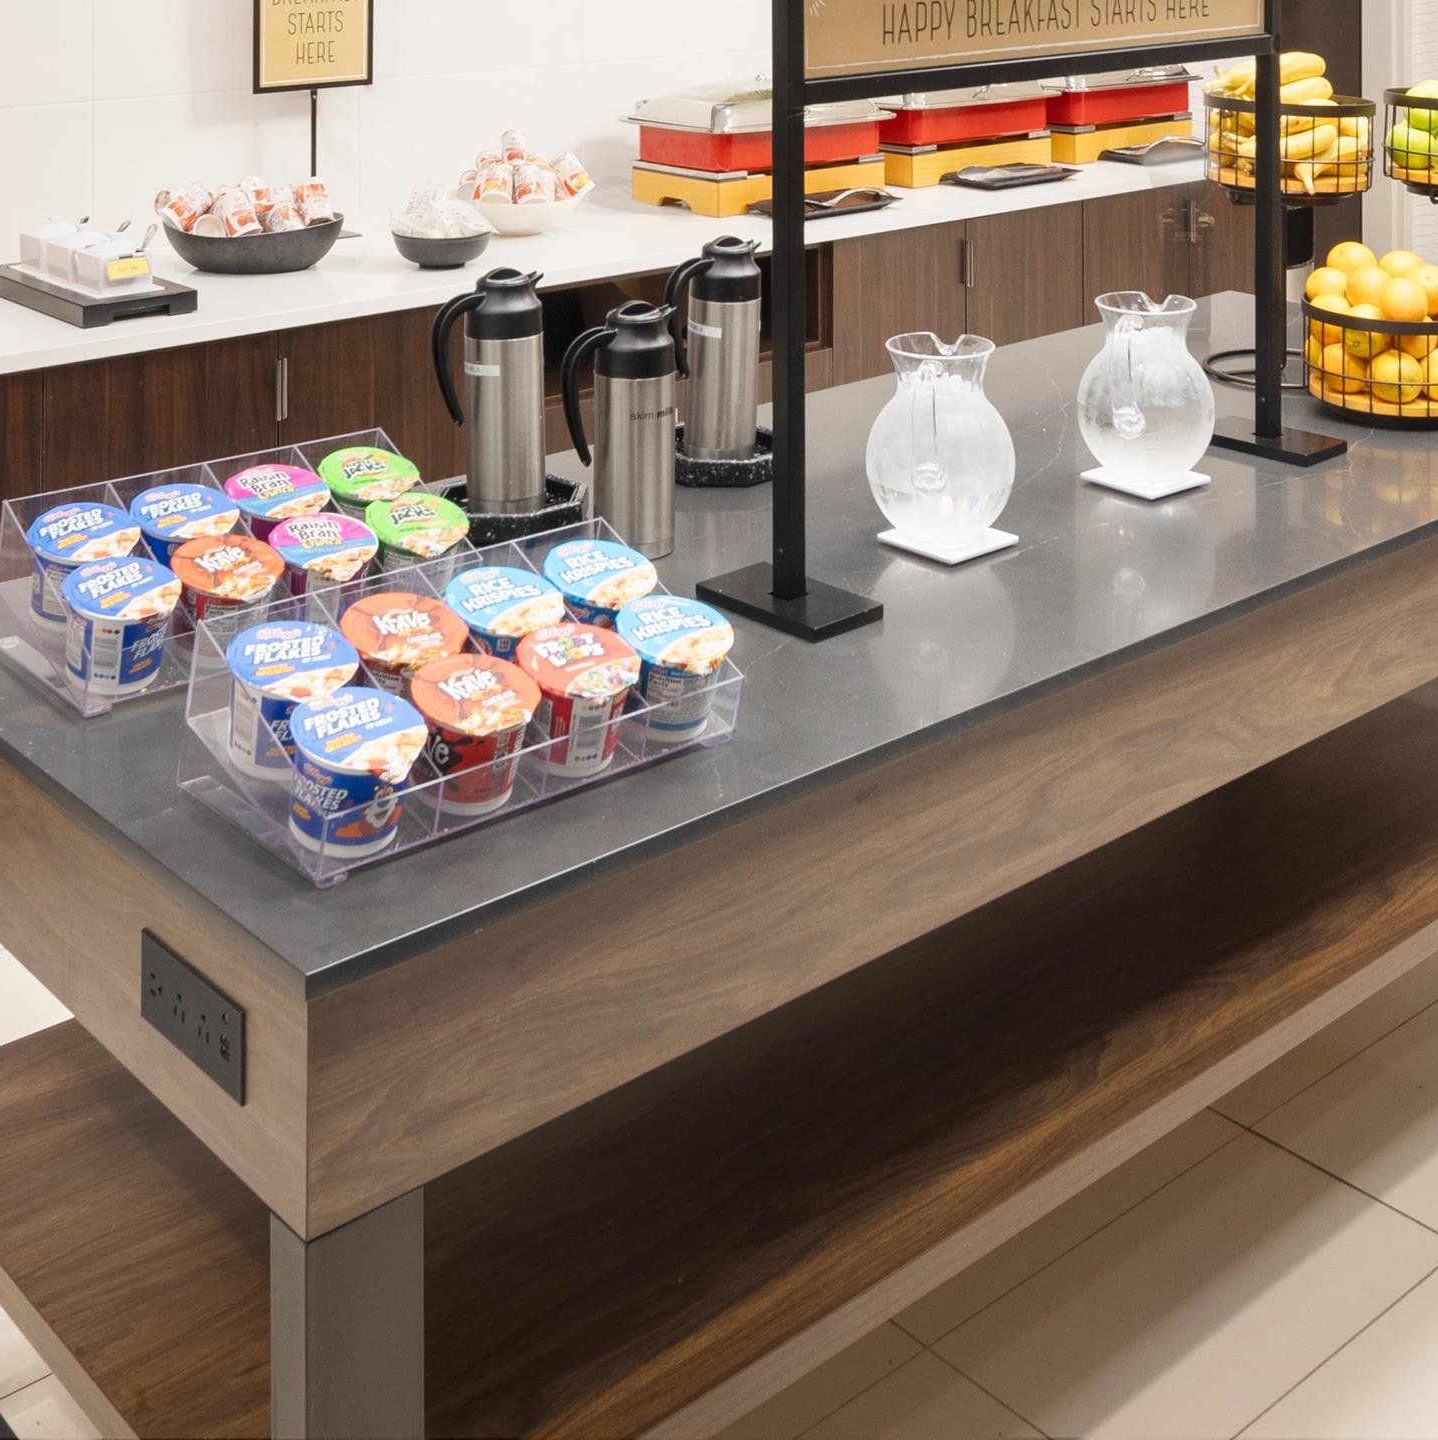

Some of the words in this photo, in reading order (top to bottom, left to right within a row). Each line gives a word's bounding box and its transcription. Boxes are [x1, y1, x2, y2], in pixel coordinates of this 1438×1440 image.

[288, 10, 344, 35] STARTS
[882, 0, 956, 45] HAPPY
[296, 40, 336, 65] HERE
[629, 411, 654, 421] skim
[239, 472, 287, 488] Raisin
[251, 479, 289, 493] Bran
[140, 492, 202, 516] FROSTED
[149, 500, 203, 520] FLAKES
[39, 509, 103, 537] FROSTED
[49, 517, 104, 540] FLAKES
[289, 520, 339, 535] Raisin
[298, 529, 338, 541] Bran
[560, 556, 637, 585] KRISPIES
[563, 550, 610, 569] RICE
[77, 562, 140, 594] FROSTED
[90, 573, 143, 599] FLAKES
[467, 577, 515, 597] RICE
[459, 584, 543, 613] KRISPIES
[632, 614, 712, 641] KRISPIES
[637, 607, 685, 625] RICE
[243, 635, 325, 657] FROSTED
[253, 645, 323, 665] FLAKES
[303, 697, 380, 732] FROSTED
[316, 708, 381, 740] FLAKES
